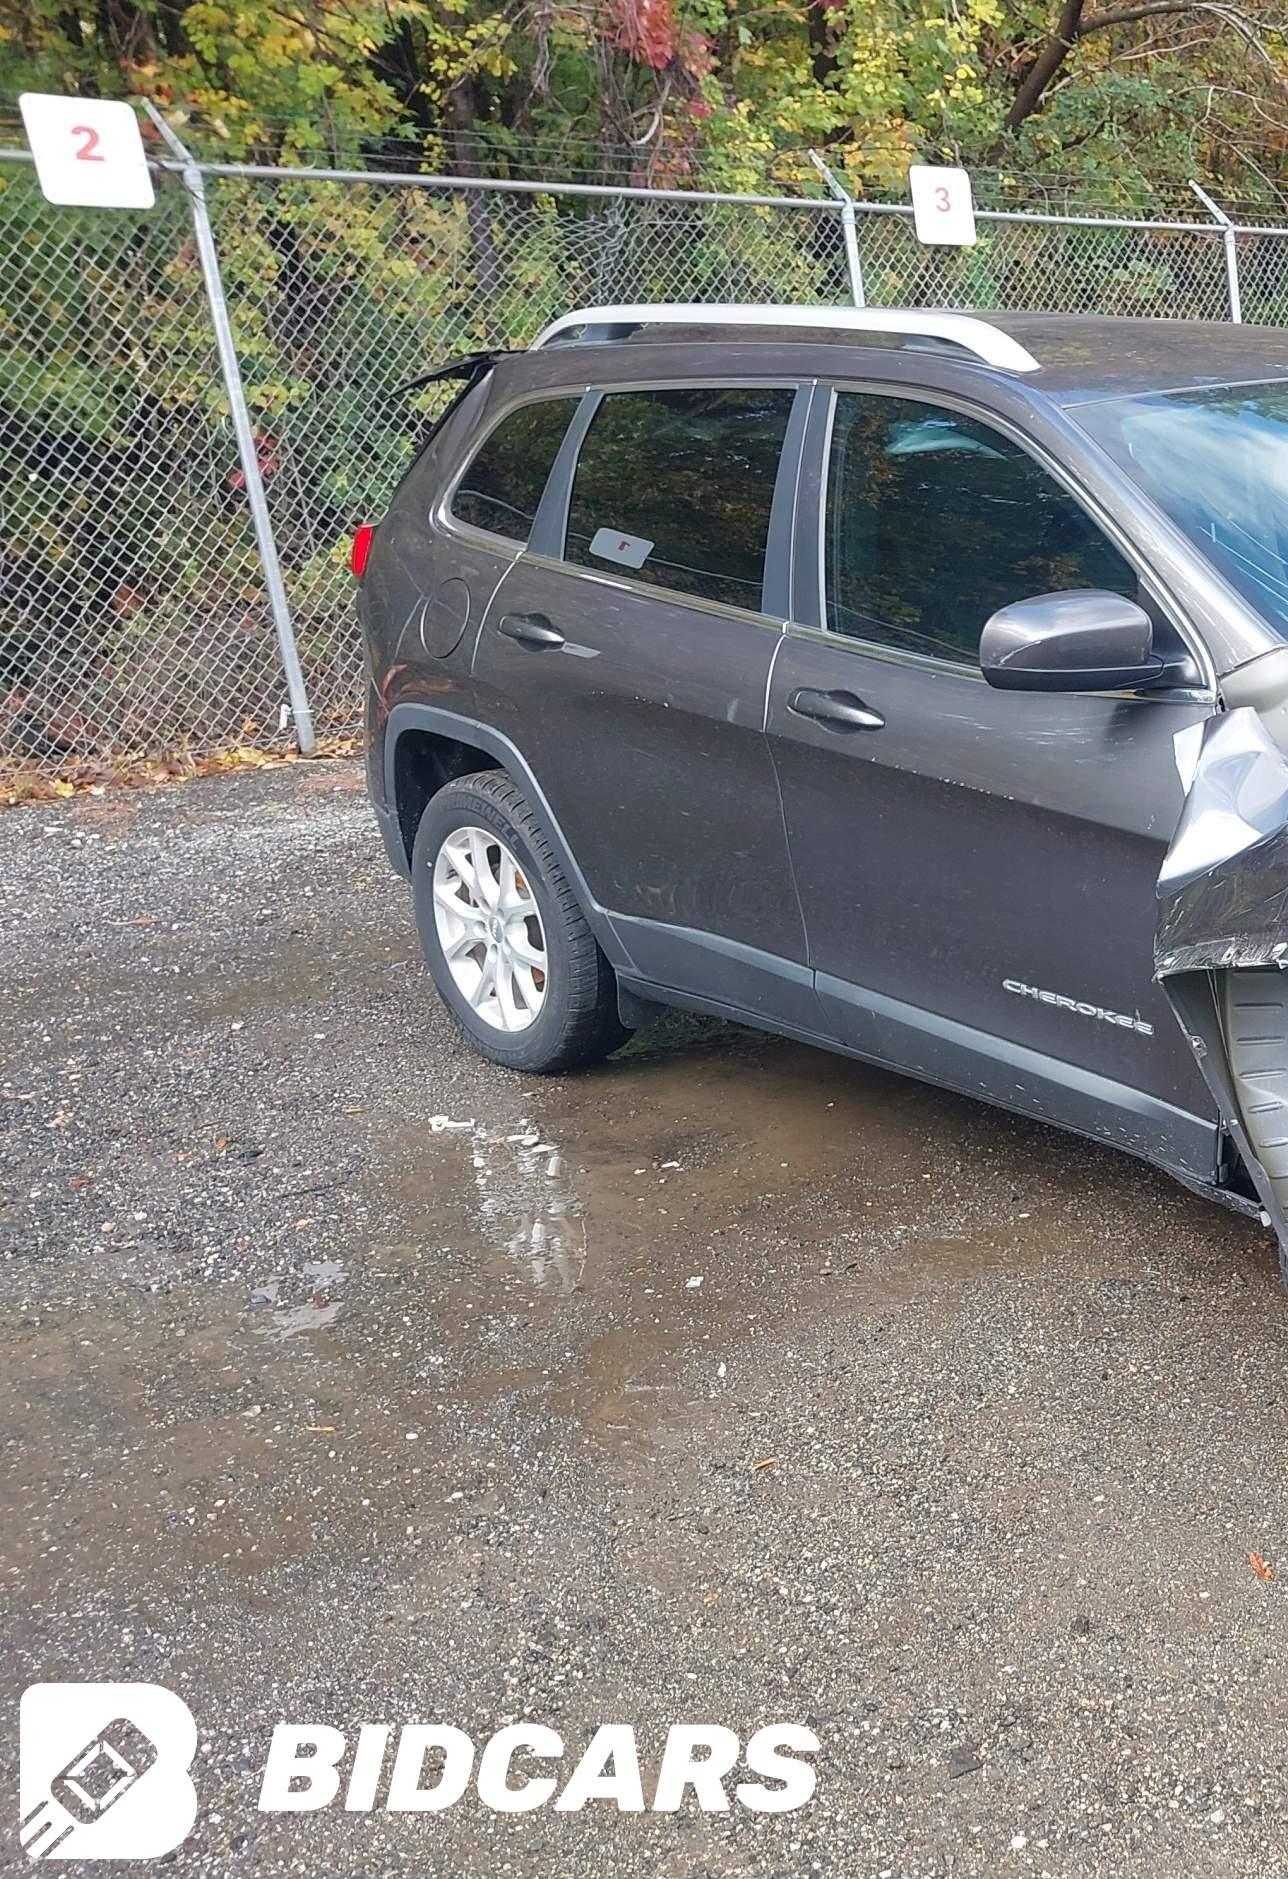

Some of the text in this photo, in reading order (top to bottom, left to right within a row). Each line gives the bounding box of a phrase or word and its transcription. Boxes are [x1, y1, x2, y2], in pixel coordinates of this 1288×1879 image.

[71, 125, 105, 162] 2
[935, 186, 951, 213] 3
[1002, 978, 1154, 1036] CHEROKEE
